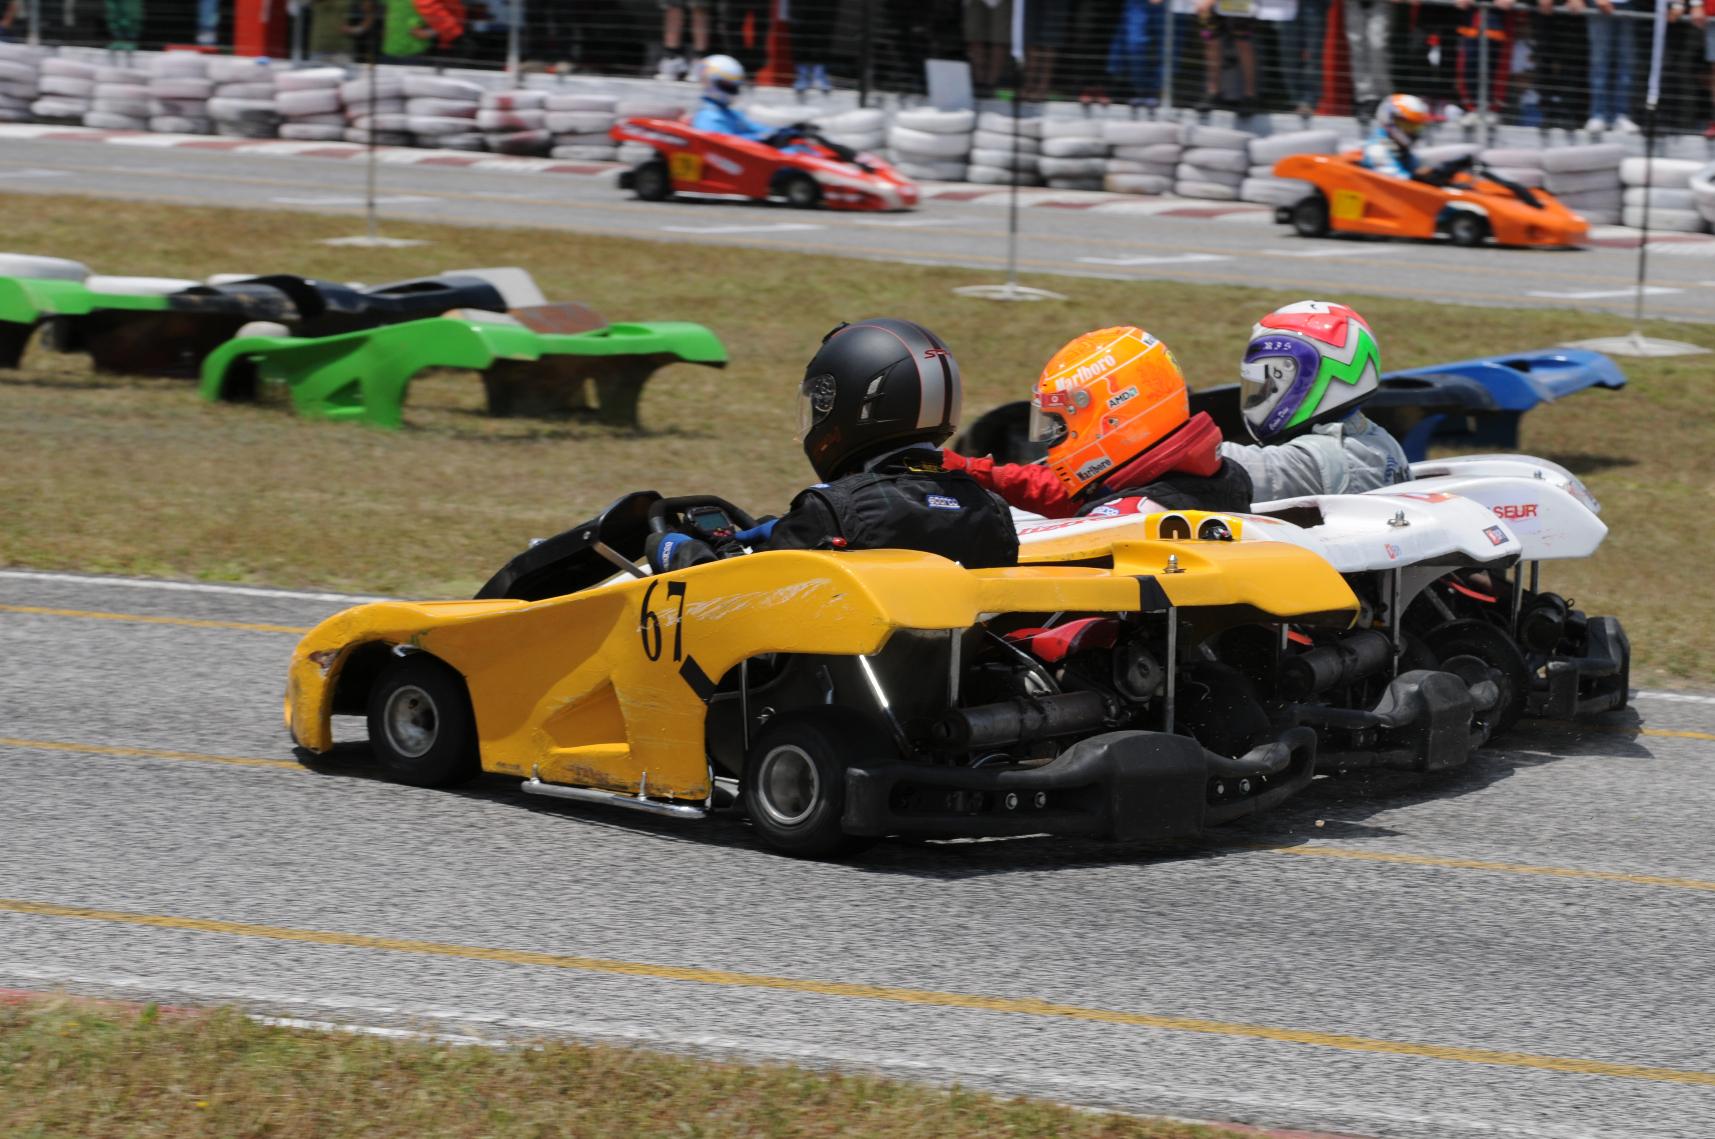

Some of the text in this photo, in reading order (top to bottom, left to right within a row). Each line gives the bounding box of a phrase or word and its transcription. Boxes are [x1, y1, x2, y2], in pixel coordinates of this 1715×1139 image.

[1055, 353, 1117, 391] Marlboro
[1109, 391, 1130, 408] AMD
[1493, 503, 1537, 519] SEUR
[640, 579, 687, 663] 67
